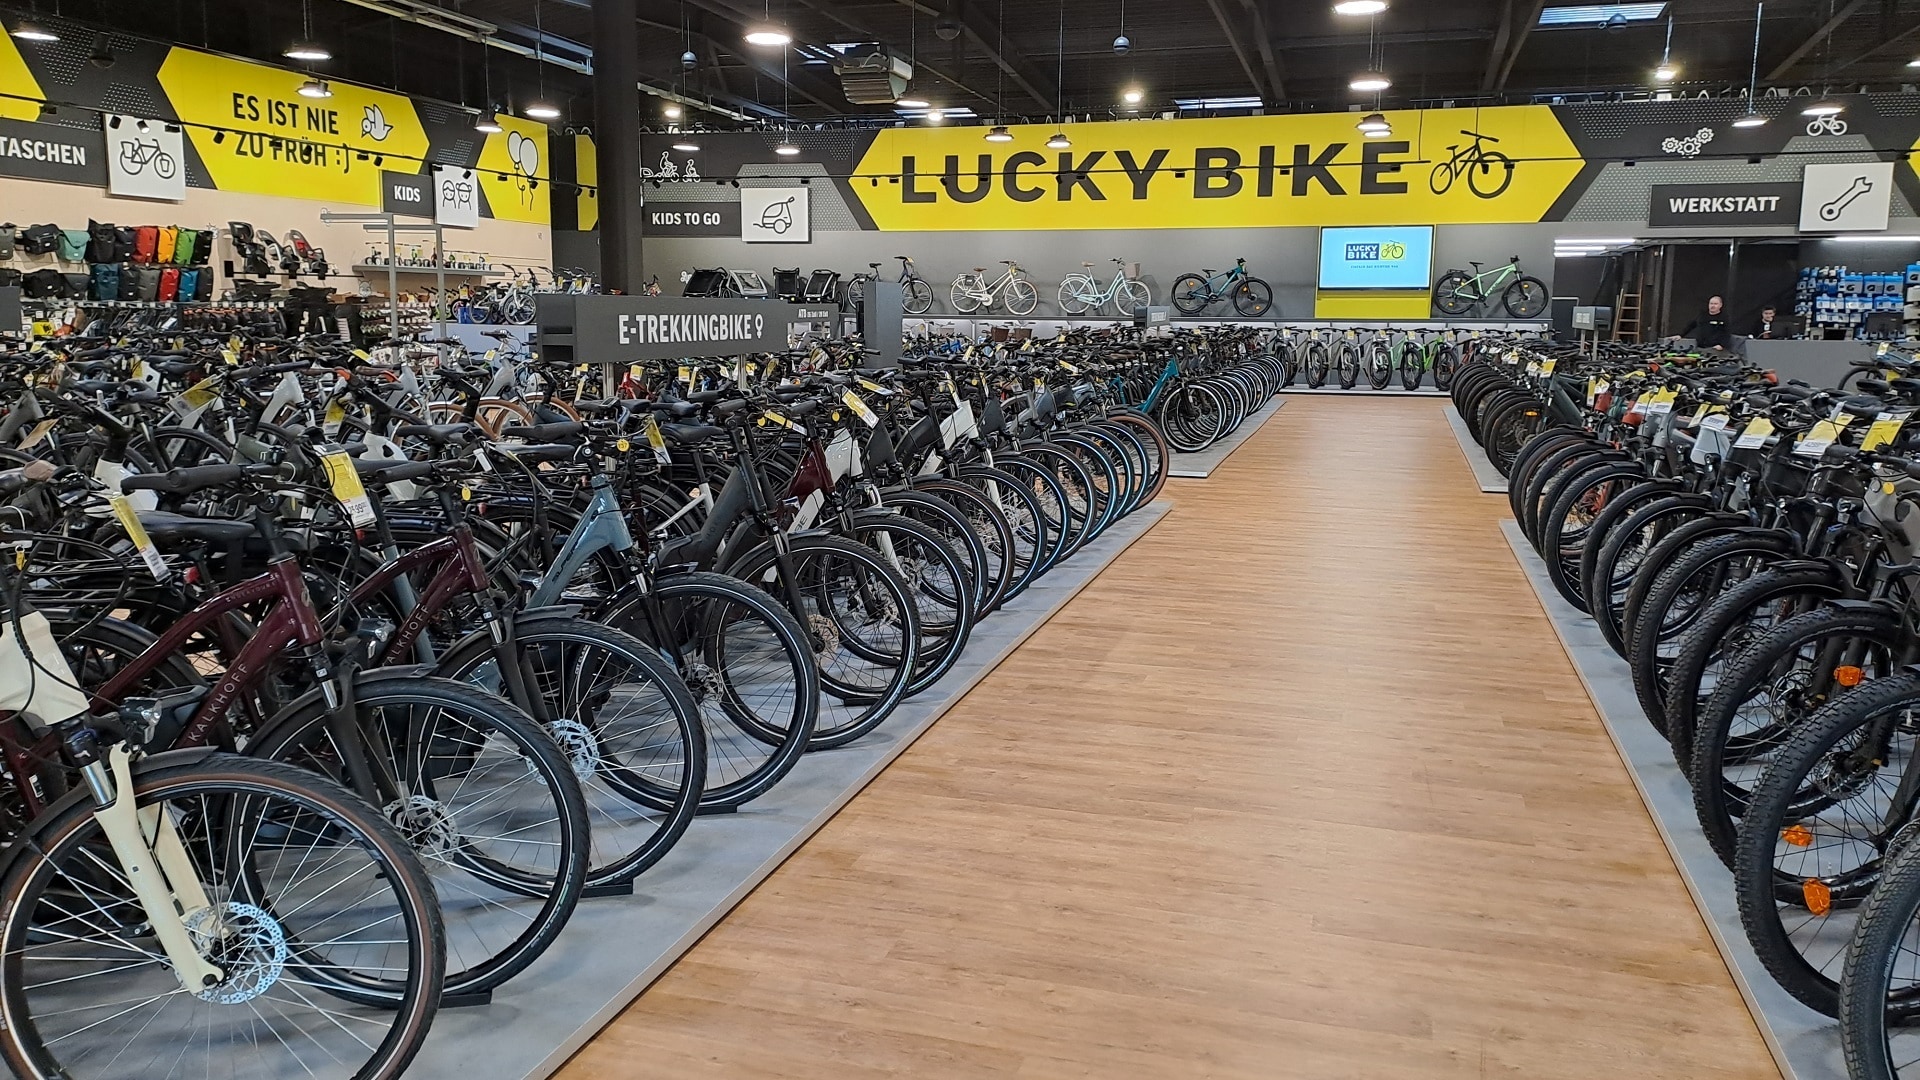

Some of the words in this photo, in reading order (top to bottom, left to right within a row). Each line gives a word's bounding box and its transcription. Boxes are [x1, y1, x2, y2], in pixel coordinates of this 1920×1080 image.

[233, 92, 260, 122] ES
[267, 99, 299, 128] IST
[307, 106, 339, 135] NIE
[0, 136, 86, 166] TASCHEN
[235, 131, 264, 158] ZU
[901, 149, 1171, 203] LUCKY
[1193, 140, 1411, 199] BIKE
[394, 185, 421, 203] KIDS
[1669, 196, 1780, 213] WERKSTATT
[652, 212, 682, 225] KIDS
[684, 212, 700, 225] TO
[703, 212, 721, 225] GO
[1347, 251, 1377, 259] BIKE
[618, 313, 752, 344] E-TREKKINGBIKE
[382, 604, 429, 667] ALKHOFF
[188, 662, 248, 742] KALKHOFF
